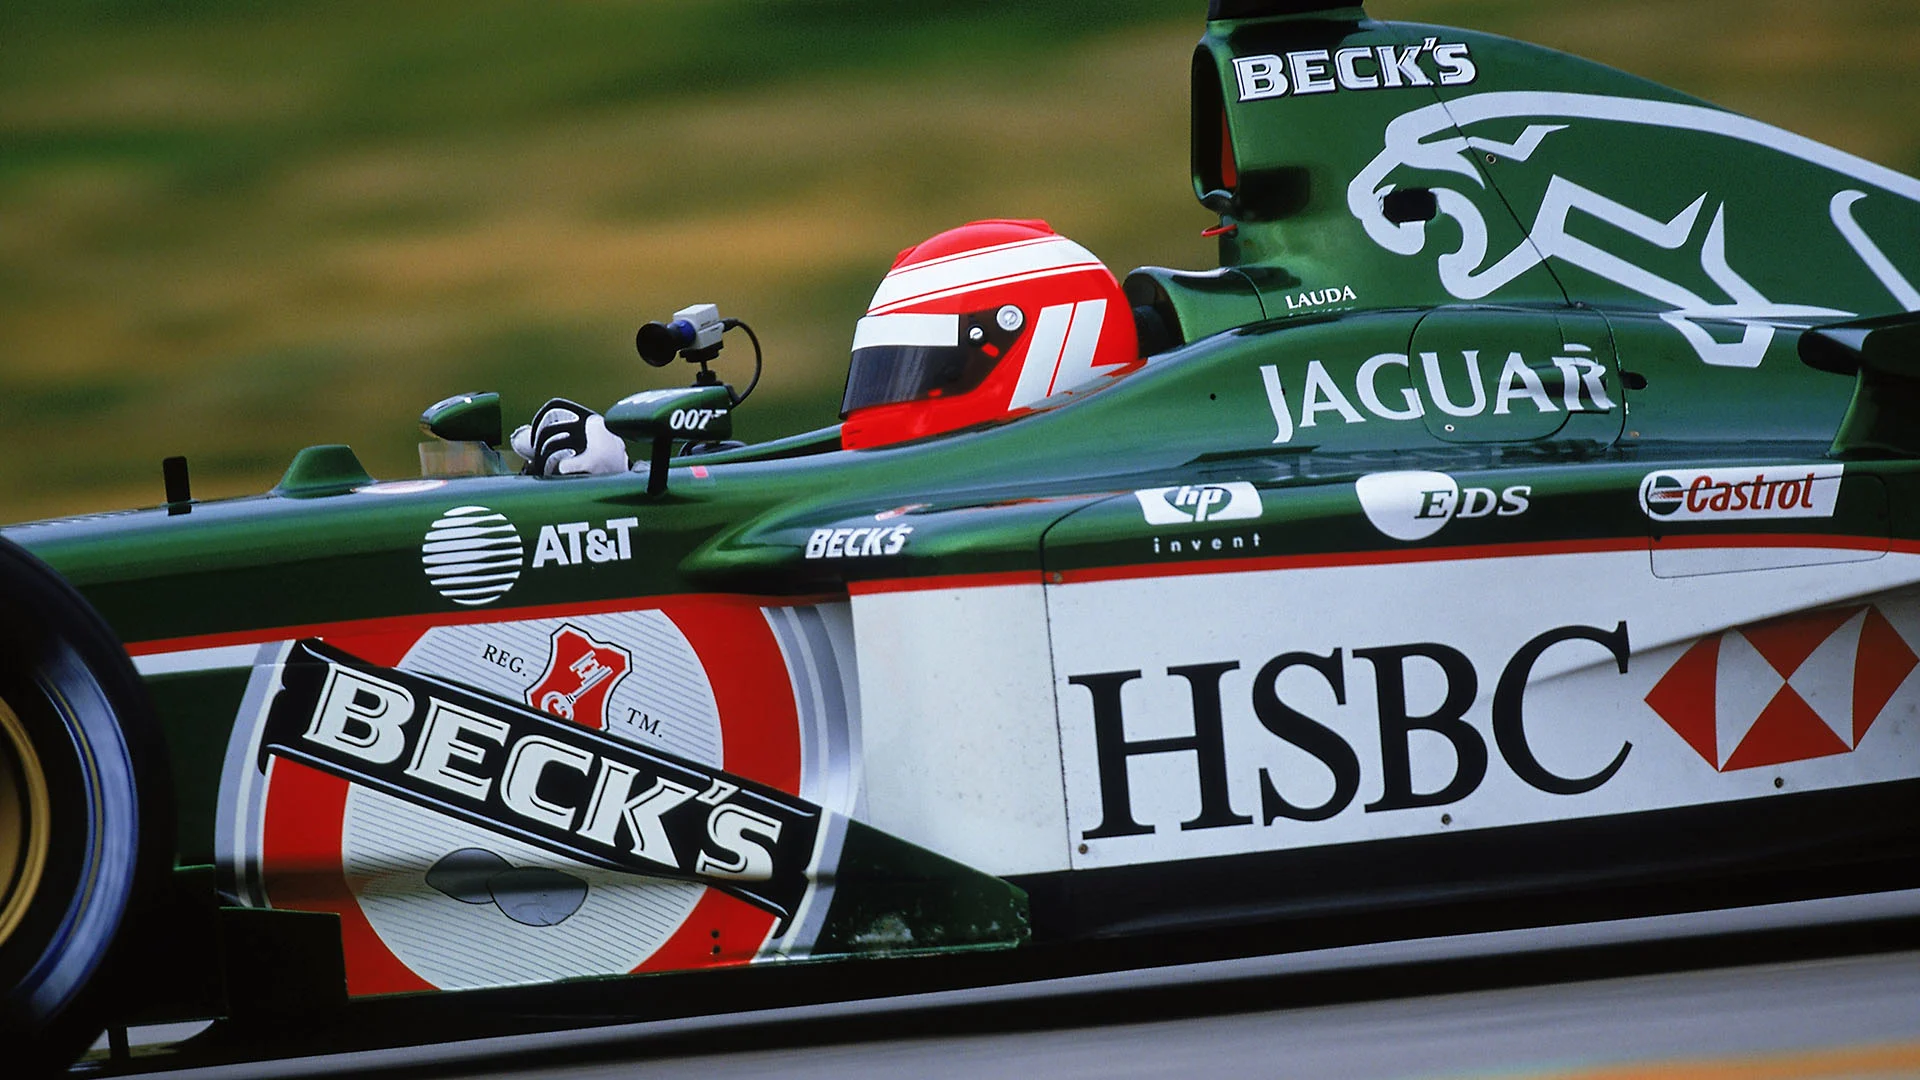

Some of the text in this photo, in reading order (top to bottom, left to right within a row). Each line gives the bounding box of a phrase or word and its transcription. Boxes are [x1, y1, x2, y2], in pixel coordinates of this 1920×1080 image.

[1232, 37, 1477, 102] BECK'S
[1285, 285, 1358, 310] LAUDA
[1259, 343, 1617, 444] JAGUAR
[669, 409, 713, 430] 007
[1175, 485, 1224, 522] hp
[1414, 486, 1532, 520] EDS
[1686, 472, 1815, 513] Castrol
[532, 517, 639, 568] AT&T
[1152, 532, 1262, 554] invent
[482, 643, 527, 677] REG.
[626, 707, 663, 738] TM.
[1068, 620, 1634, 840] HSBC
[302, 662, 783, 880] BECK'S
